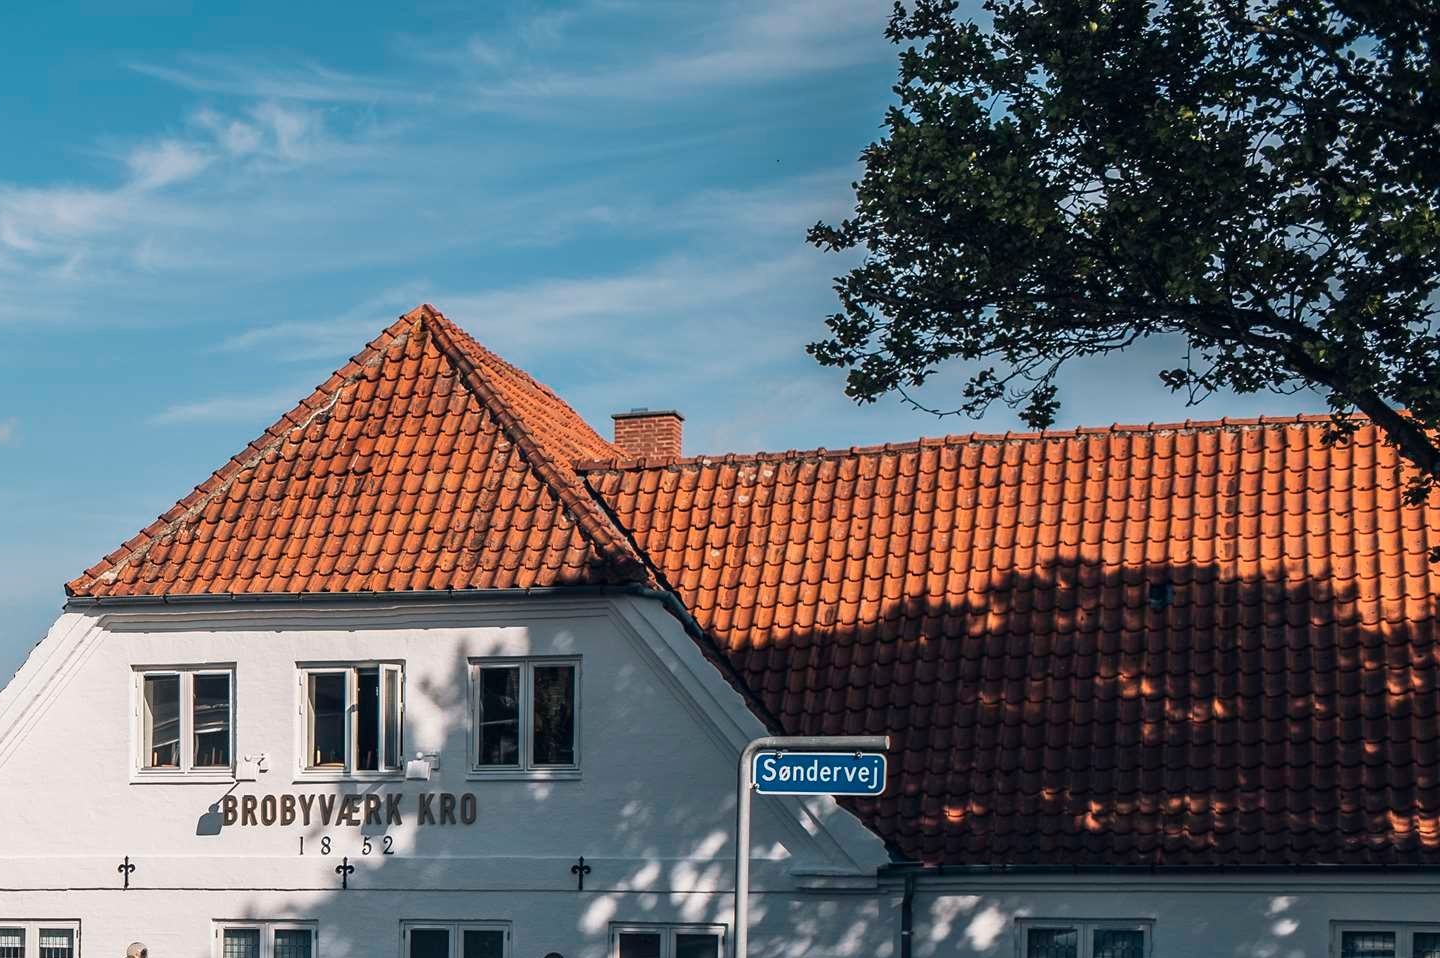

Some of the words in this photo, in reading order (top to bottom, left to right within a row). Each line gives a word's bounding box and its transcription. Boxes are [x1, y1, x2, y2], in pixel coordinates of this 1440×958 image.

[761, 758, 879, 789] Søndervej
[222, 794, 403, 826] BROBYVÆRK
[416, 793, 477, 825] KRO
